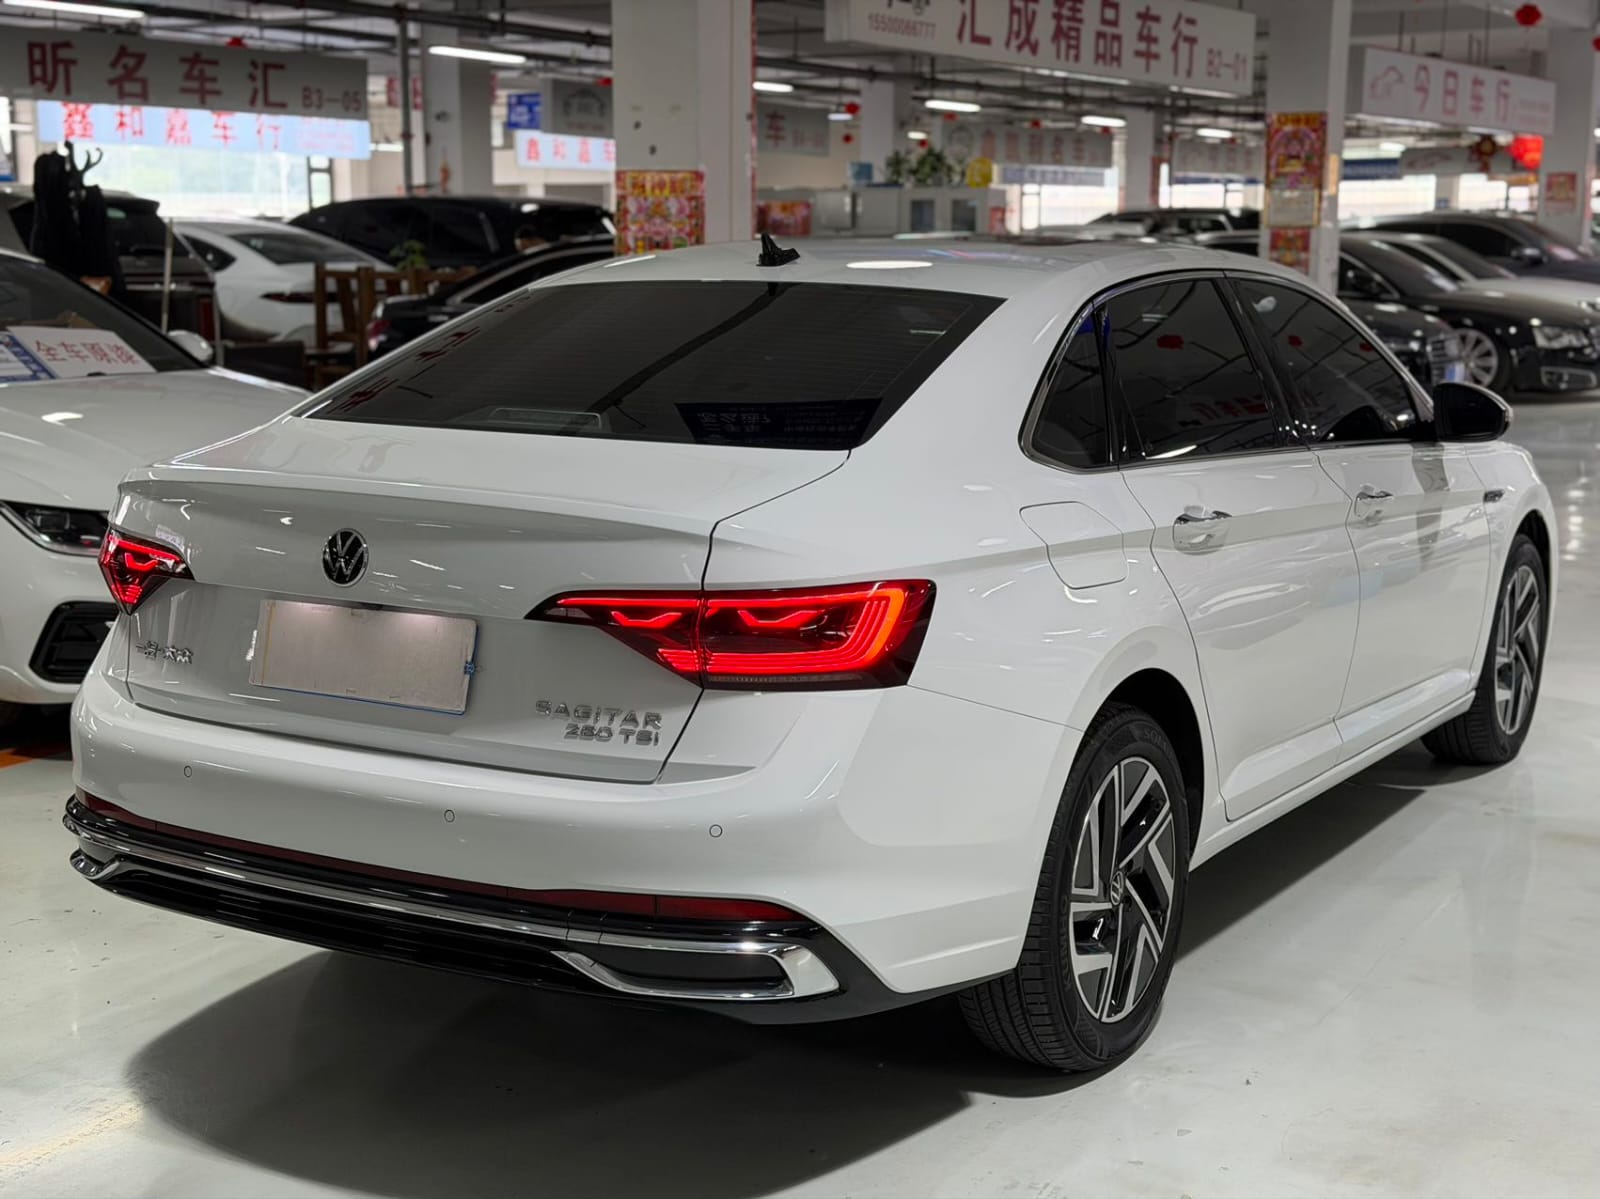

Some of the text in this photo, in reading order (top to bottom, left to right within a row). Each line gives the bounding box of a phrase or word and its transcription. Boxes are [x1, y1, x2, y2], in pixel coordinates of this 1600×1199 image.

[956, 0, 1198, 79] 汇成精品车行
[27, 40, 289, 110] 昕名车汇
[1413, 63, 1512, 124] 今日车行
[535, 699, 663, 730] SAGITAR
[619, 727, 660, 747] TSI
